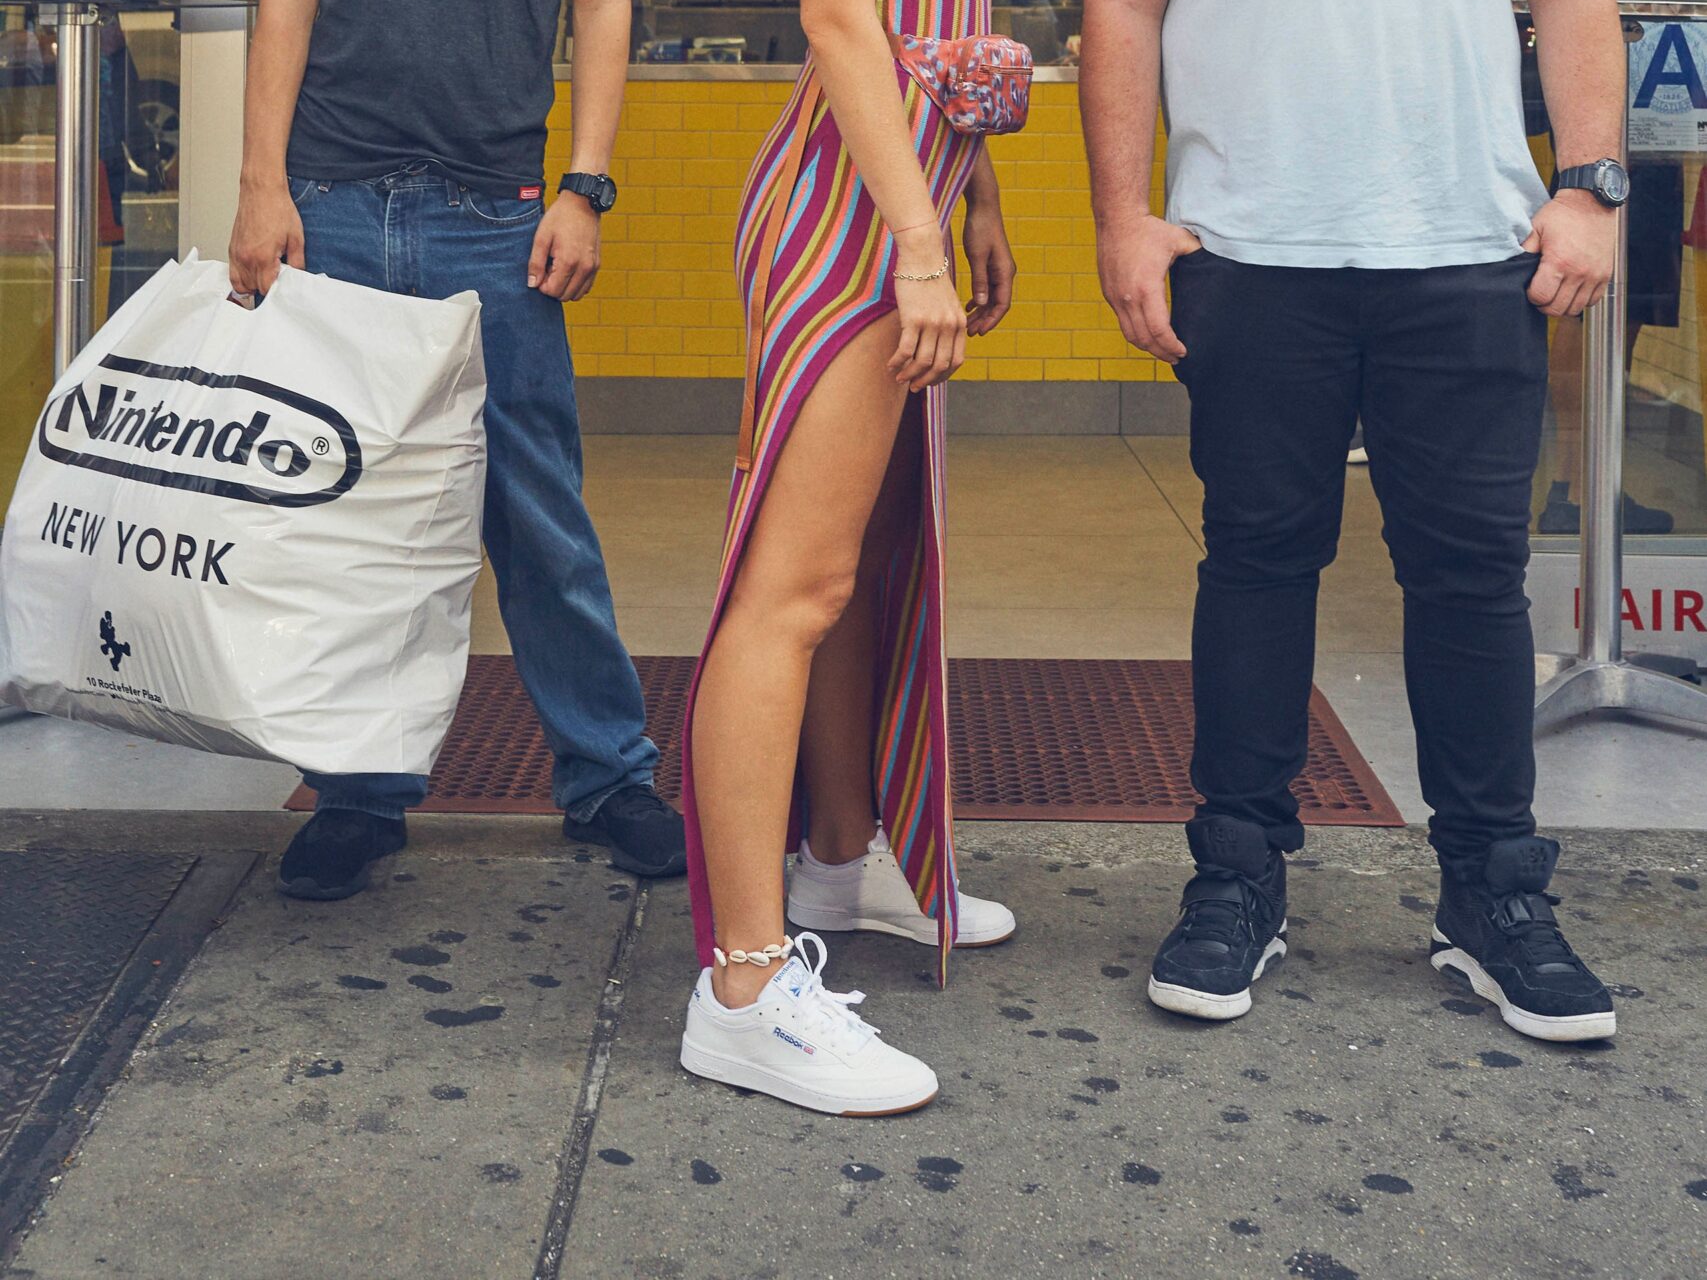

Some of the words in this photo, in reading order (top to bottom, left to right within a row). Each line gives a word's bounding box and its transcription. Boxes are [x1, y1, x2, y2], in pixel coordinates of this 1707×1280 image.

[1633, 24, 1707, 109] A
[55, 383, 311, 478] Nintendo
[41, 502, 105, 556] NEW
[117, 520, 236, 586] YORK
[1574, 587, 1707, 632] AIR
[86, 677, 97, 687] 10
[773, 1026, 804, 1050] Reebok
